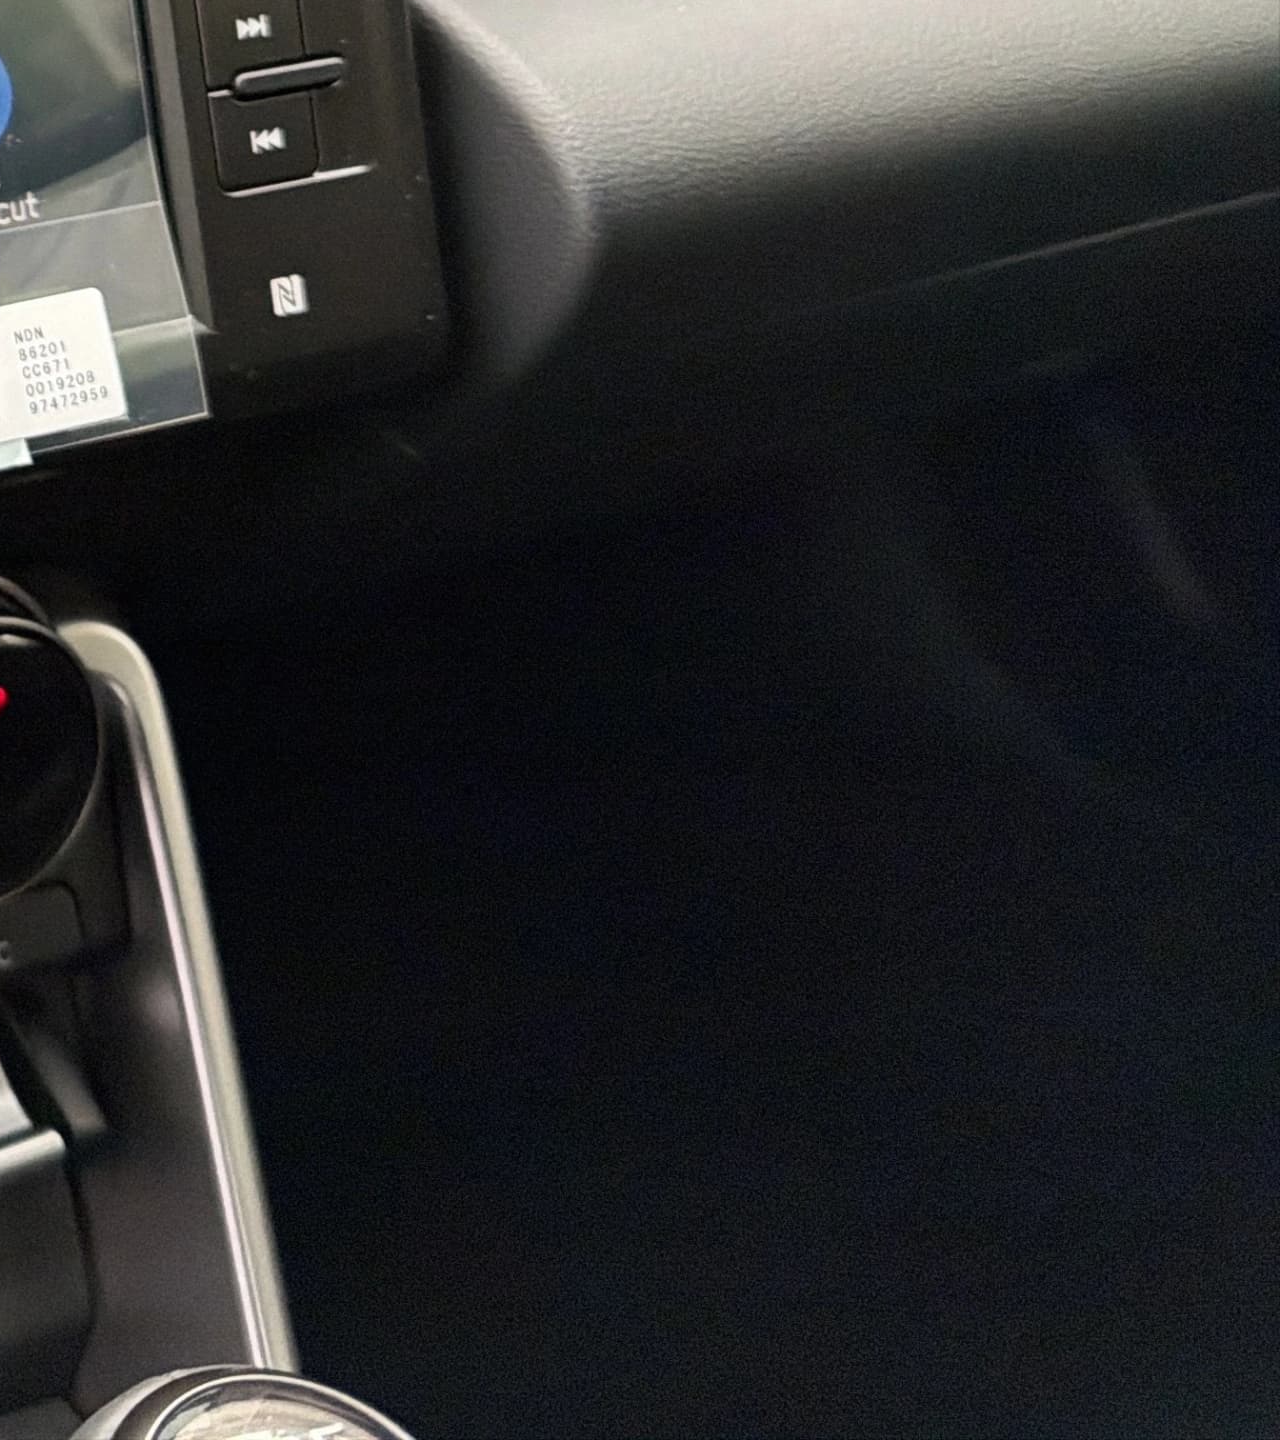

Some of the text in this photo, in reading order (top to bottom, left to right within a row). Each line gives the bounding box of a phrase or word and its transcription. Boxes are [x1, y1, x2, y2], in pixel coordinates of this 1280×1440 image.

[13, 326, 45, 344] NDN
[17, 339, 67, 362] 86201
[21, 357, 71, 380] CC671
[25, 369, 95, 398] 0019208
